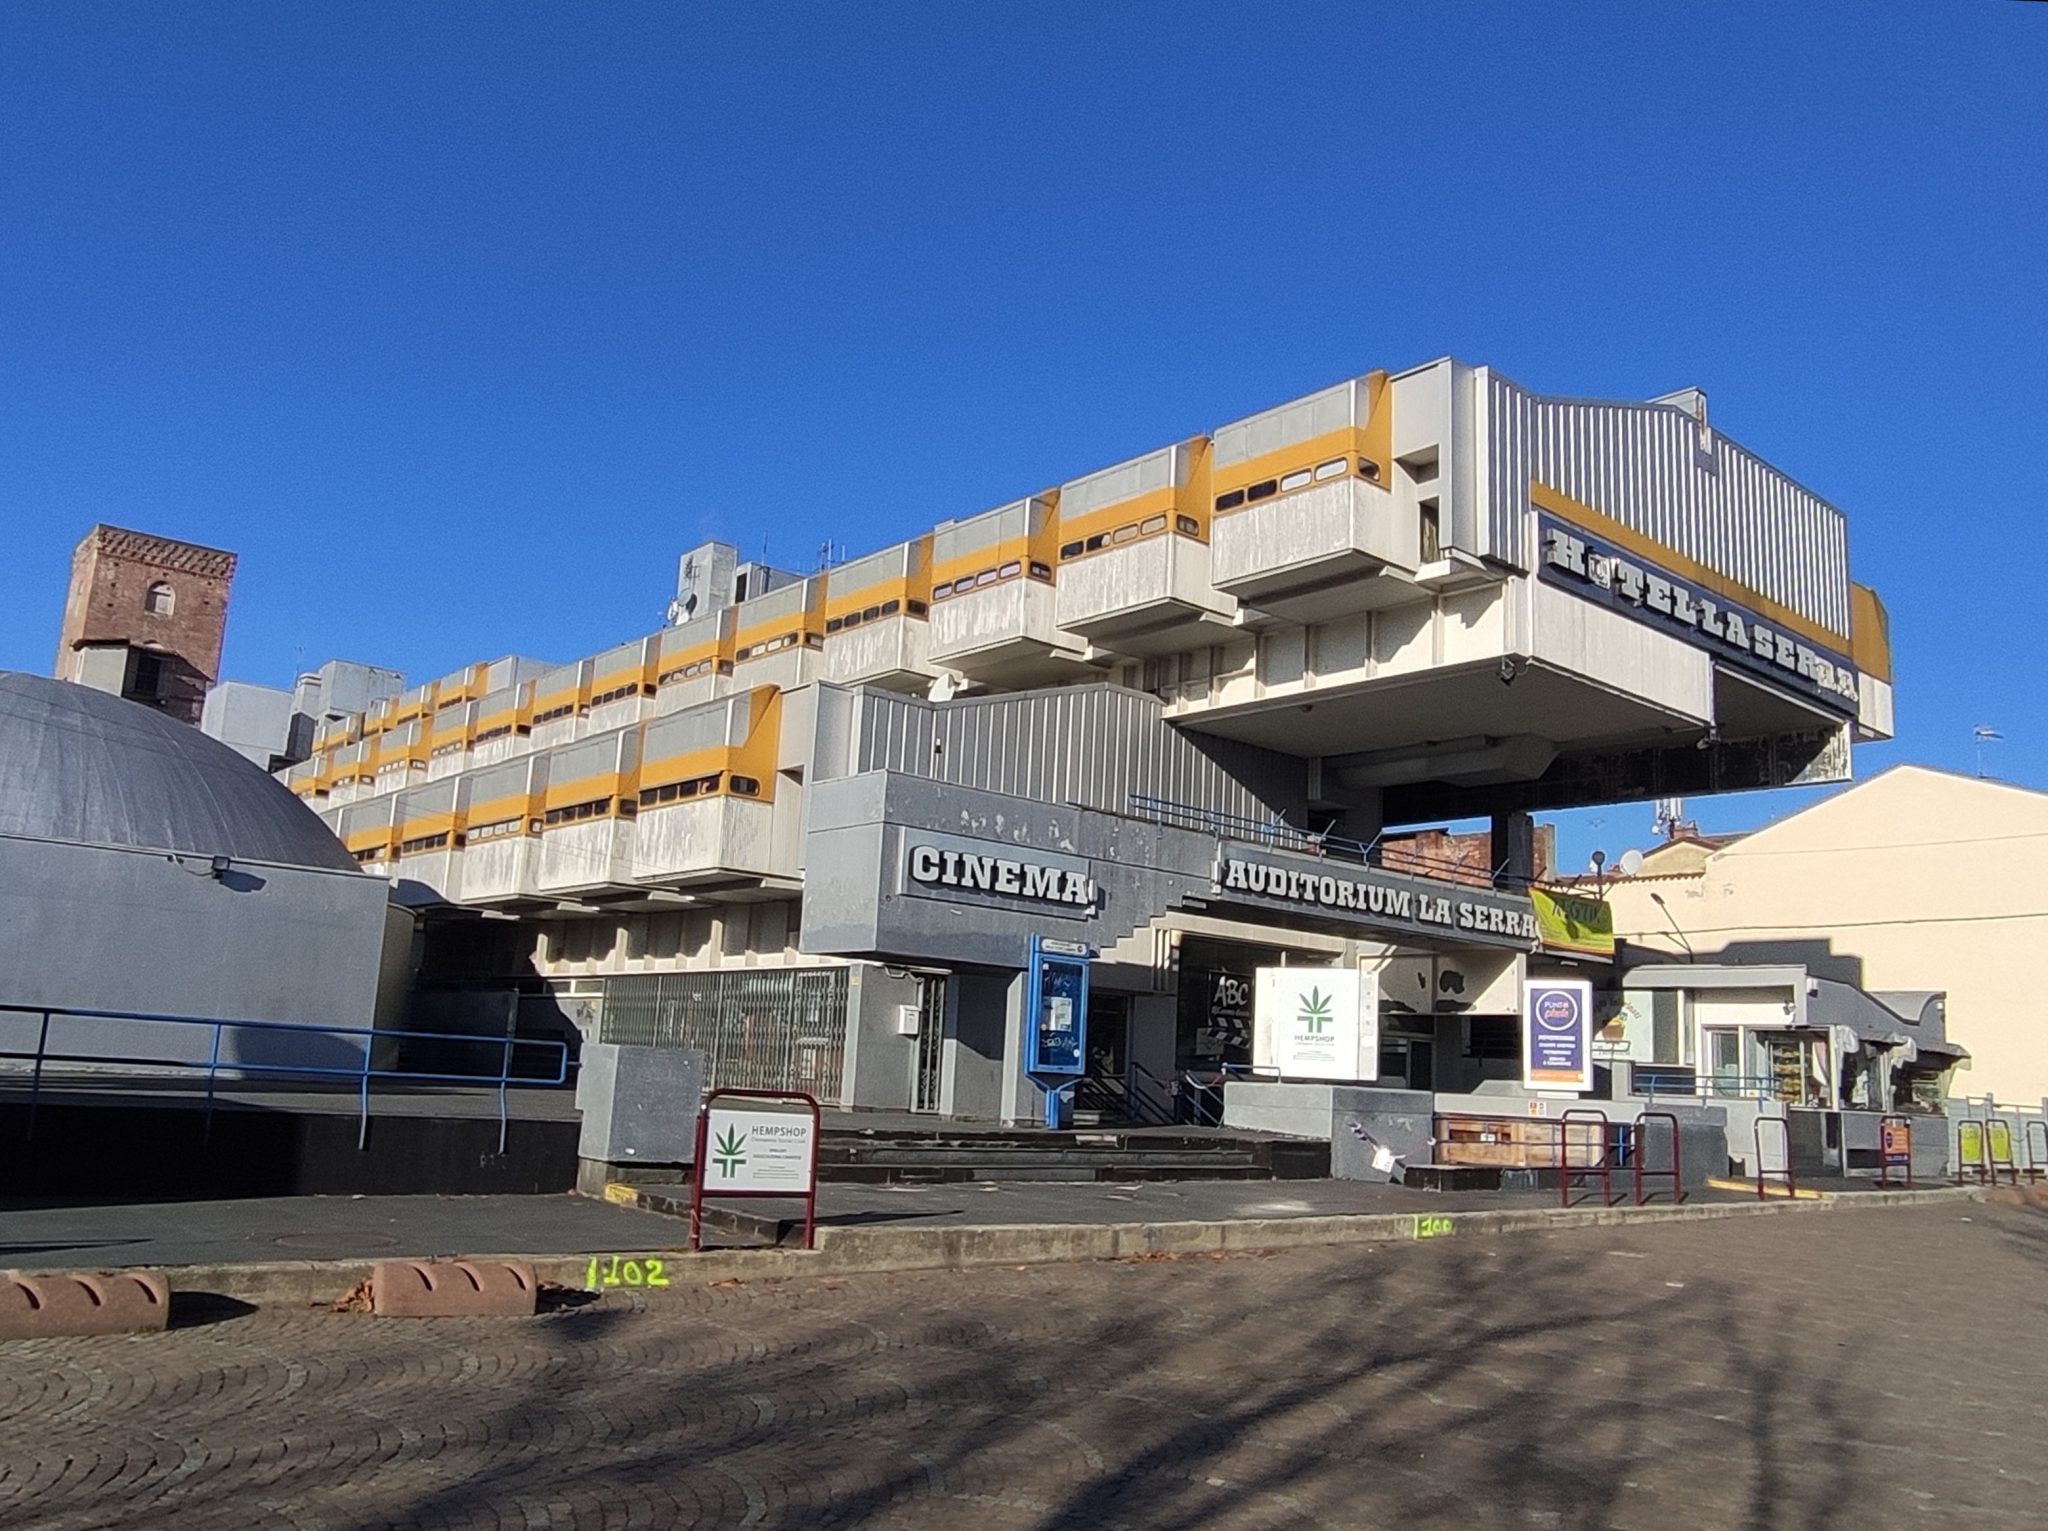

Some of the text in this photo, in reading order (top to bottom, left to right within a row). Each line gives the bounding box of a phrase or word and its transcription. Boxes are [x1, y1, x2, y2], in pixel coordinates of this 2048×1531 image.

[1549, 527, 1860, 702] HOTEL LA SERRA
[911, 844, 1089, 905] CINEMA
[1225, 859, 1411, 918] AUDITORIUM
[1418, 893, 1453, 925] LA
[1459, 901, 1539, 939] SERRA
[1212, 975, 1249, 1008] ABC
[1294, 1034, 1335, 1043] HEMPSHOP
[751, 1125, 807, 1137] HEMPSHOP
